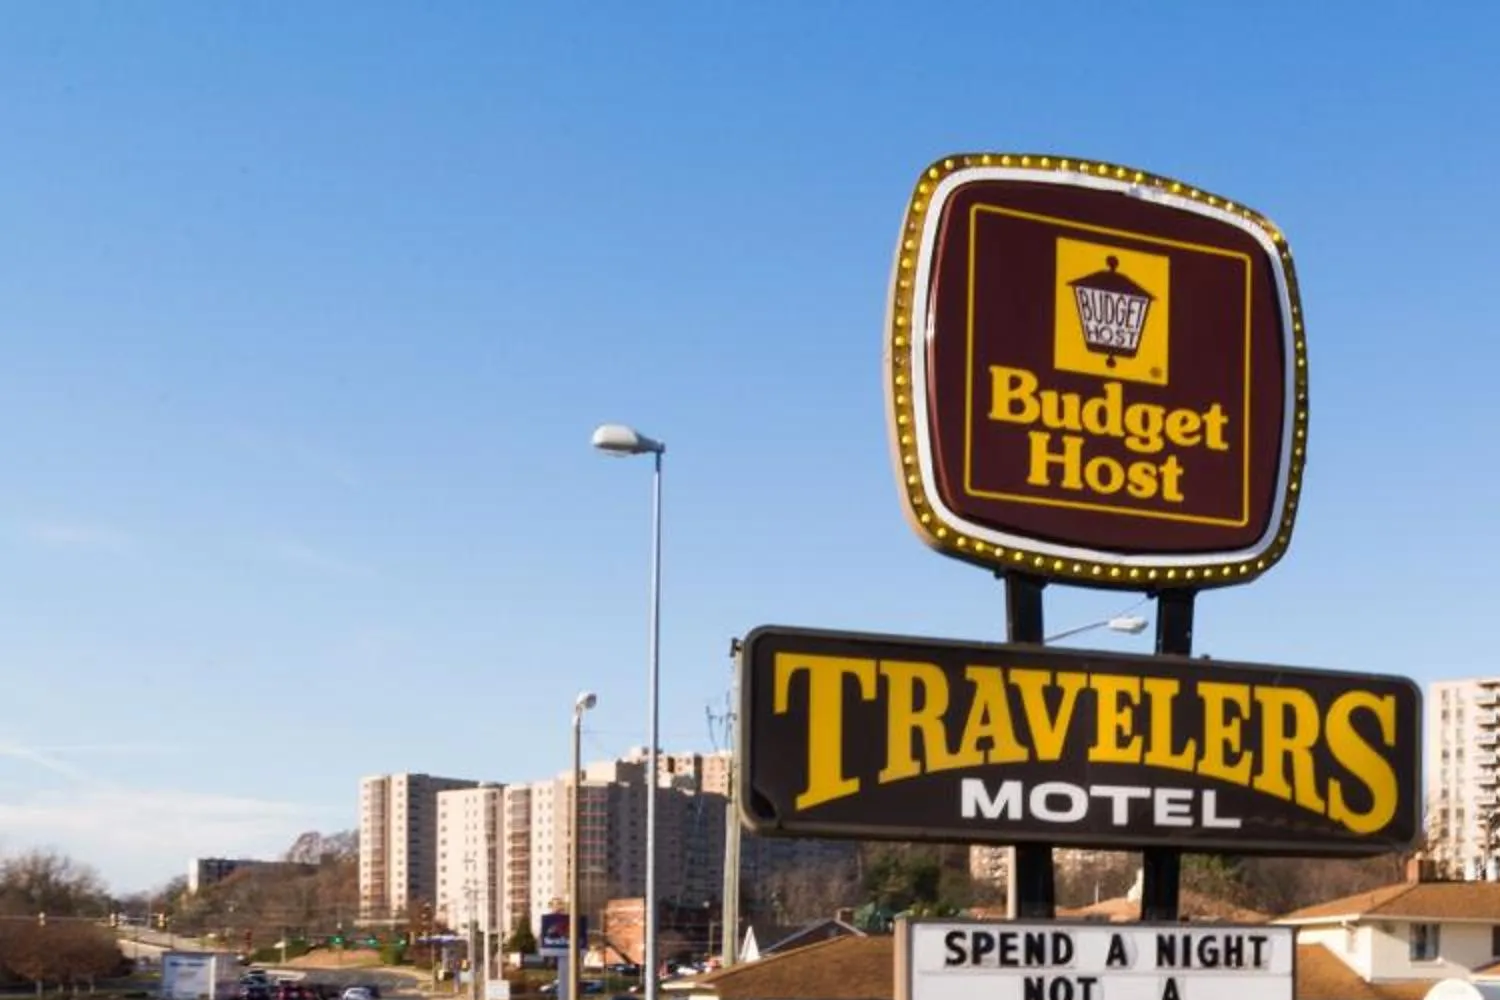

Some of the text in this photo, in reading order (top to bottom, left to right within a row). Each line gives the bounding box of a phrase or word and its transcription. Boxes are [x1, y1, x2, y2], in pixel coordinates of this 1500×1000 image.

[1079, 288, 1147, 330] BUDGET
[1085, 323, 1136, 346] HOST
[987, 365, 1230, 453] Budget
[1027, 431, 1184, 502] Host
[773, 651, 1399, 835] TRAVELERS
[960, 777, 1242, 829] MOTEL
[944, 931, 1268, 968] SPEND A NIGHT
